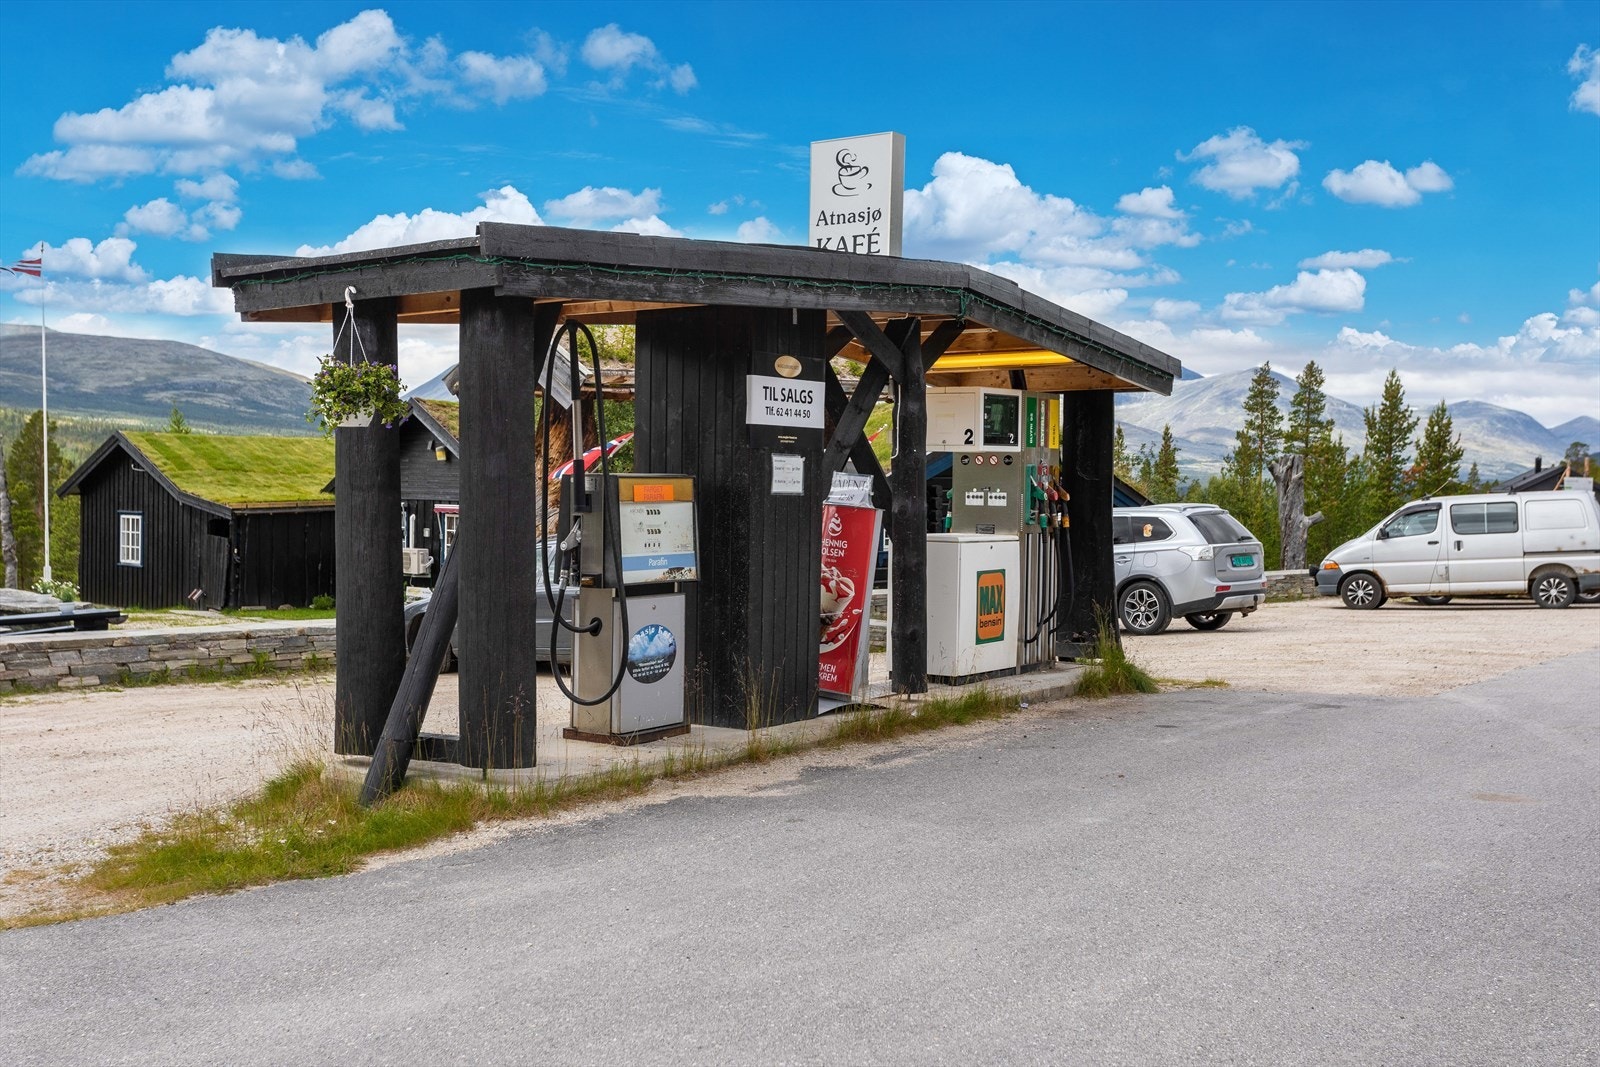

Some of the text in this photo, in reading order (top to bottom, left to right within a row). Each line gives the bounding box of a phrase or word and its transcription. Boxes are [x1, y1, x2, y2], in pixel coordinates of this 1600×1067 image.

[816, 207, 882, 226] Atnasjø
[816, 227, 881, 254] KAFÉ
[763, 386, 813, 405] TIL SALGS
[765, 406, 811, 419] Tlf. 62 41 44 50
[964, 428, 974, 445] 2
[1009, 433, 1014, 444] 2
[821, 547, 845, 558] OLSEN
[648, 557, 668, 567] Parafin
[979, 585, 1003, 616] MAX
[980, 617, 1002, 629] bensin
